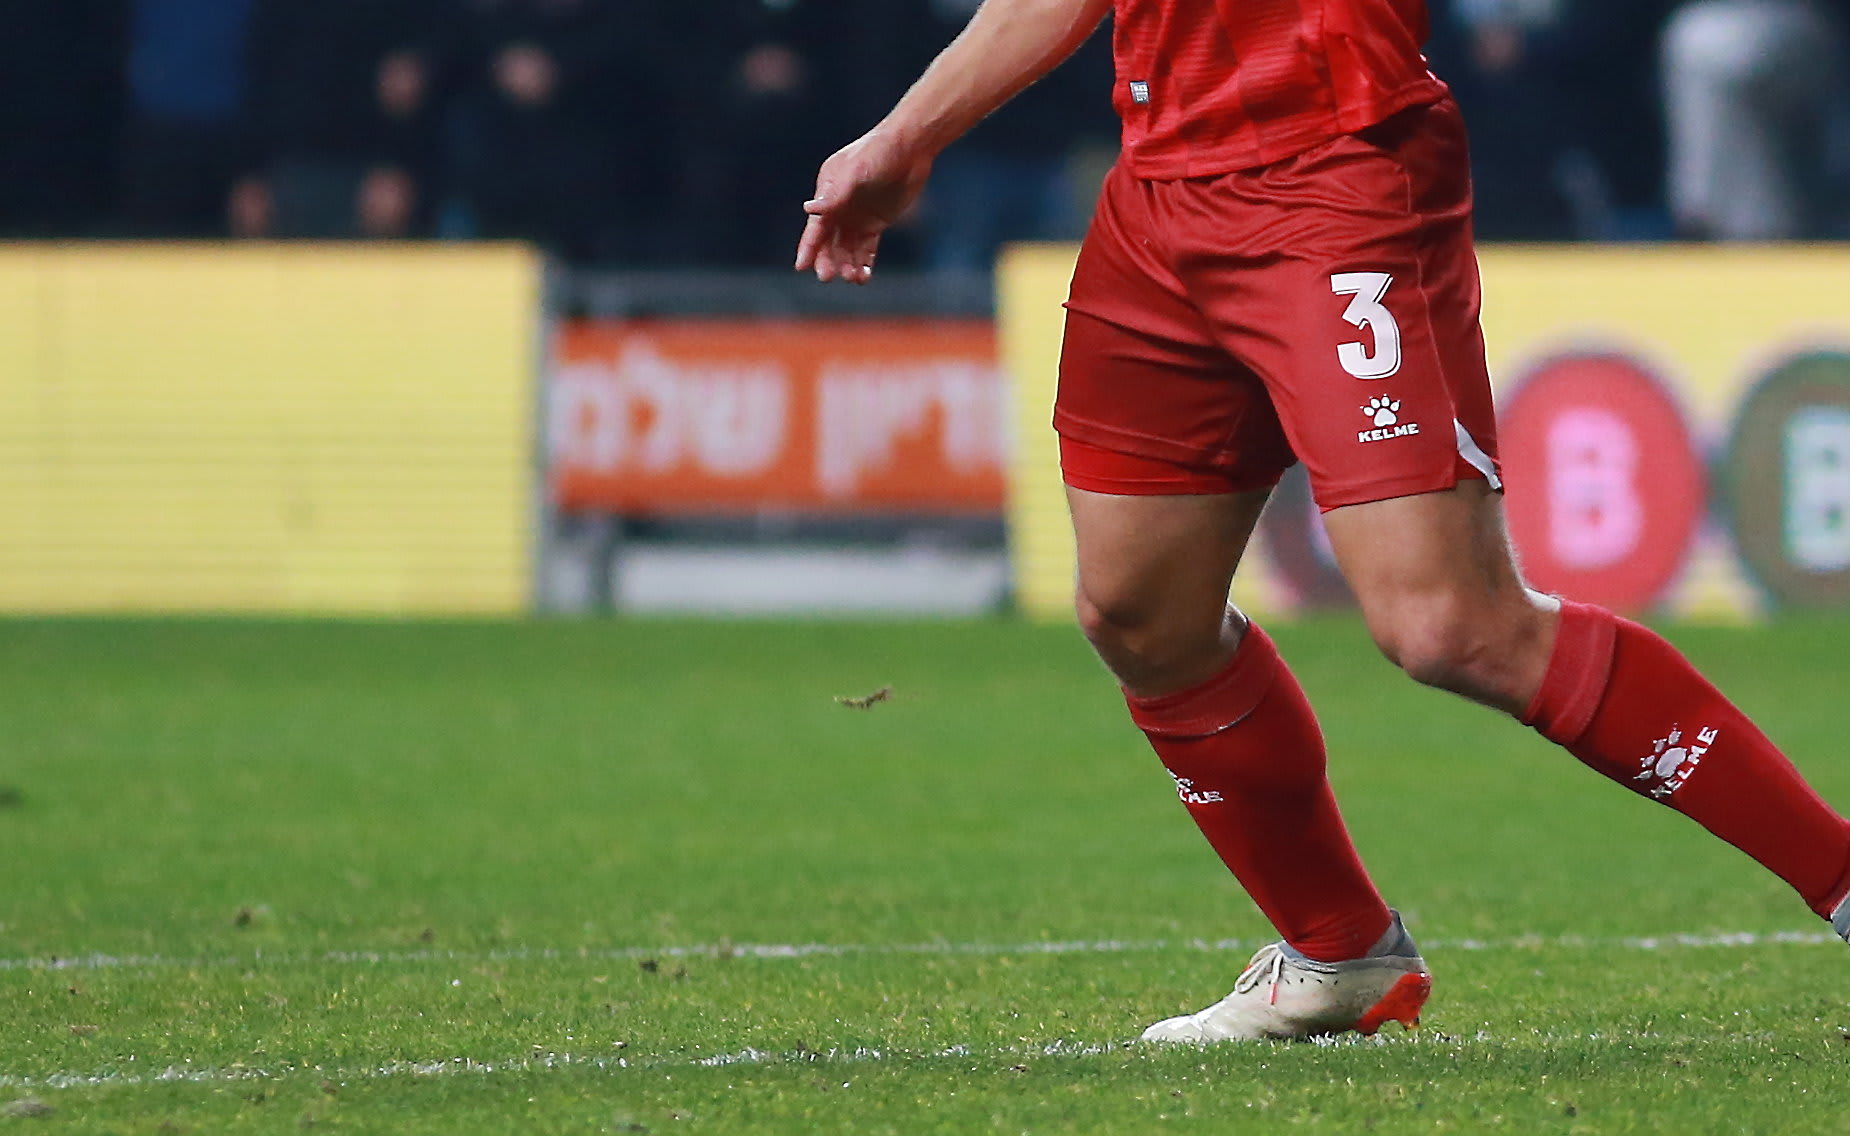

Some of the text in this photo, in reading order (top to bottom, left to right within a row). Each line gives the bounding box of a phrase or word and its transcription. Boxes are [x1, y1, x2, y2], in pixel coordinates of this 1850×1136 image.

[1330, 272, 1401, 381] 3
[1358, 423, 1420, 444] KELME
[1650, 725, 1719, 799] KELME
